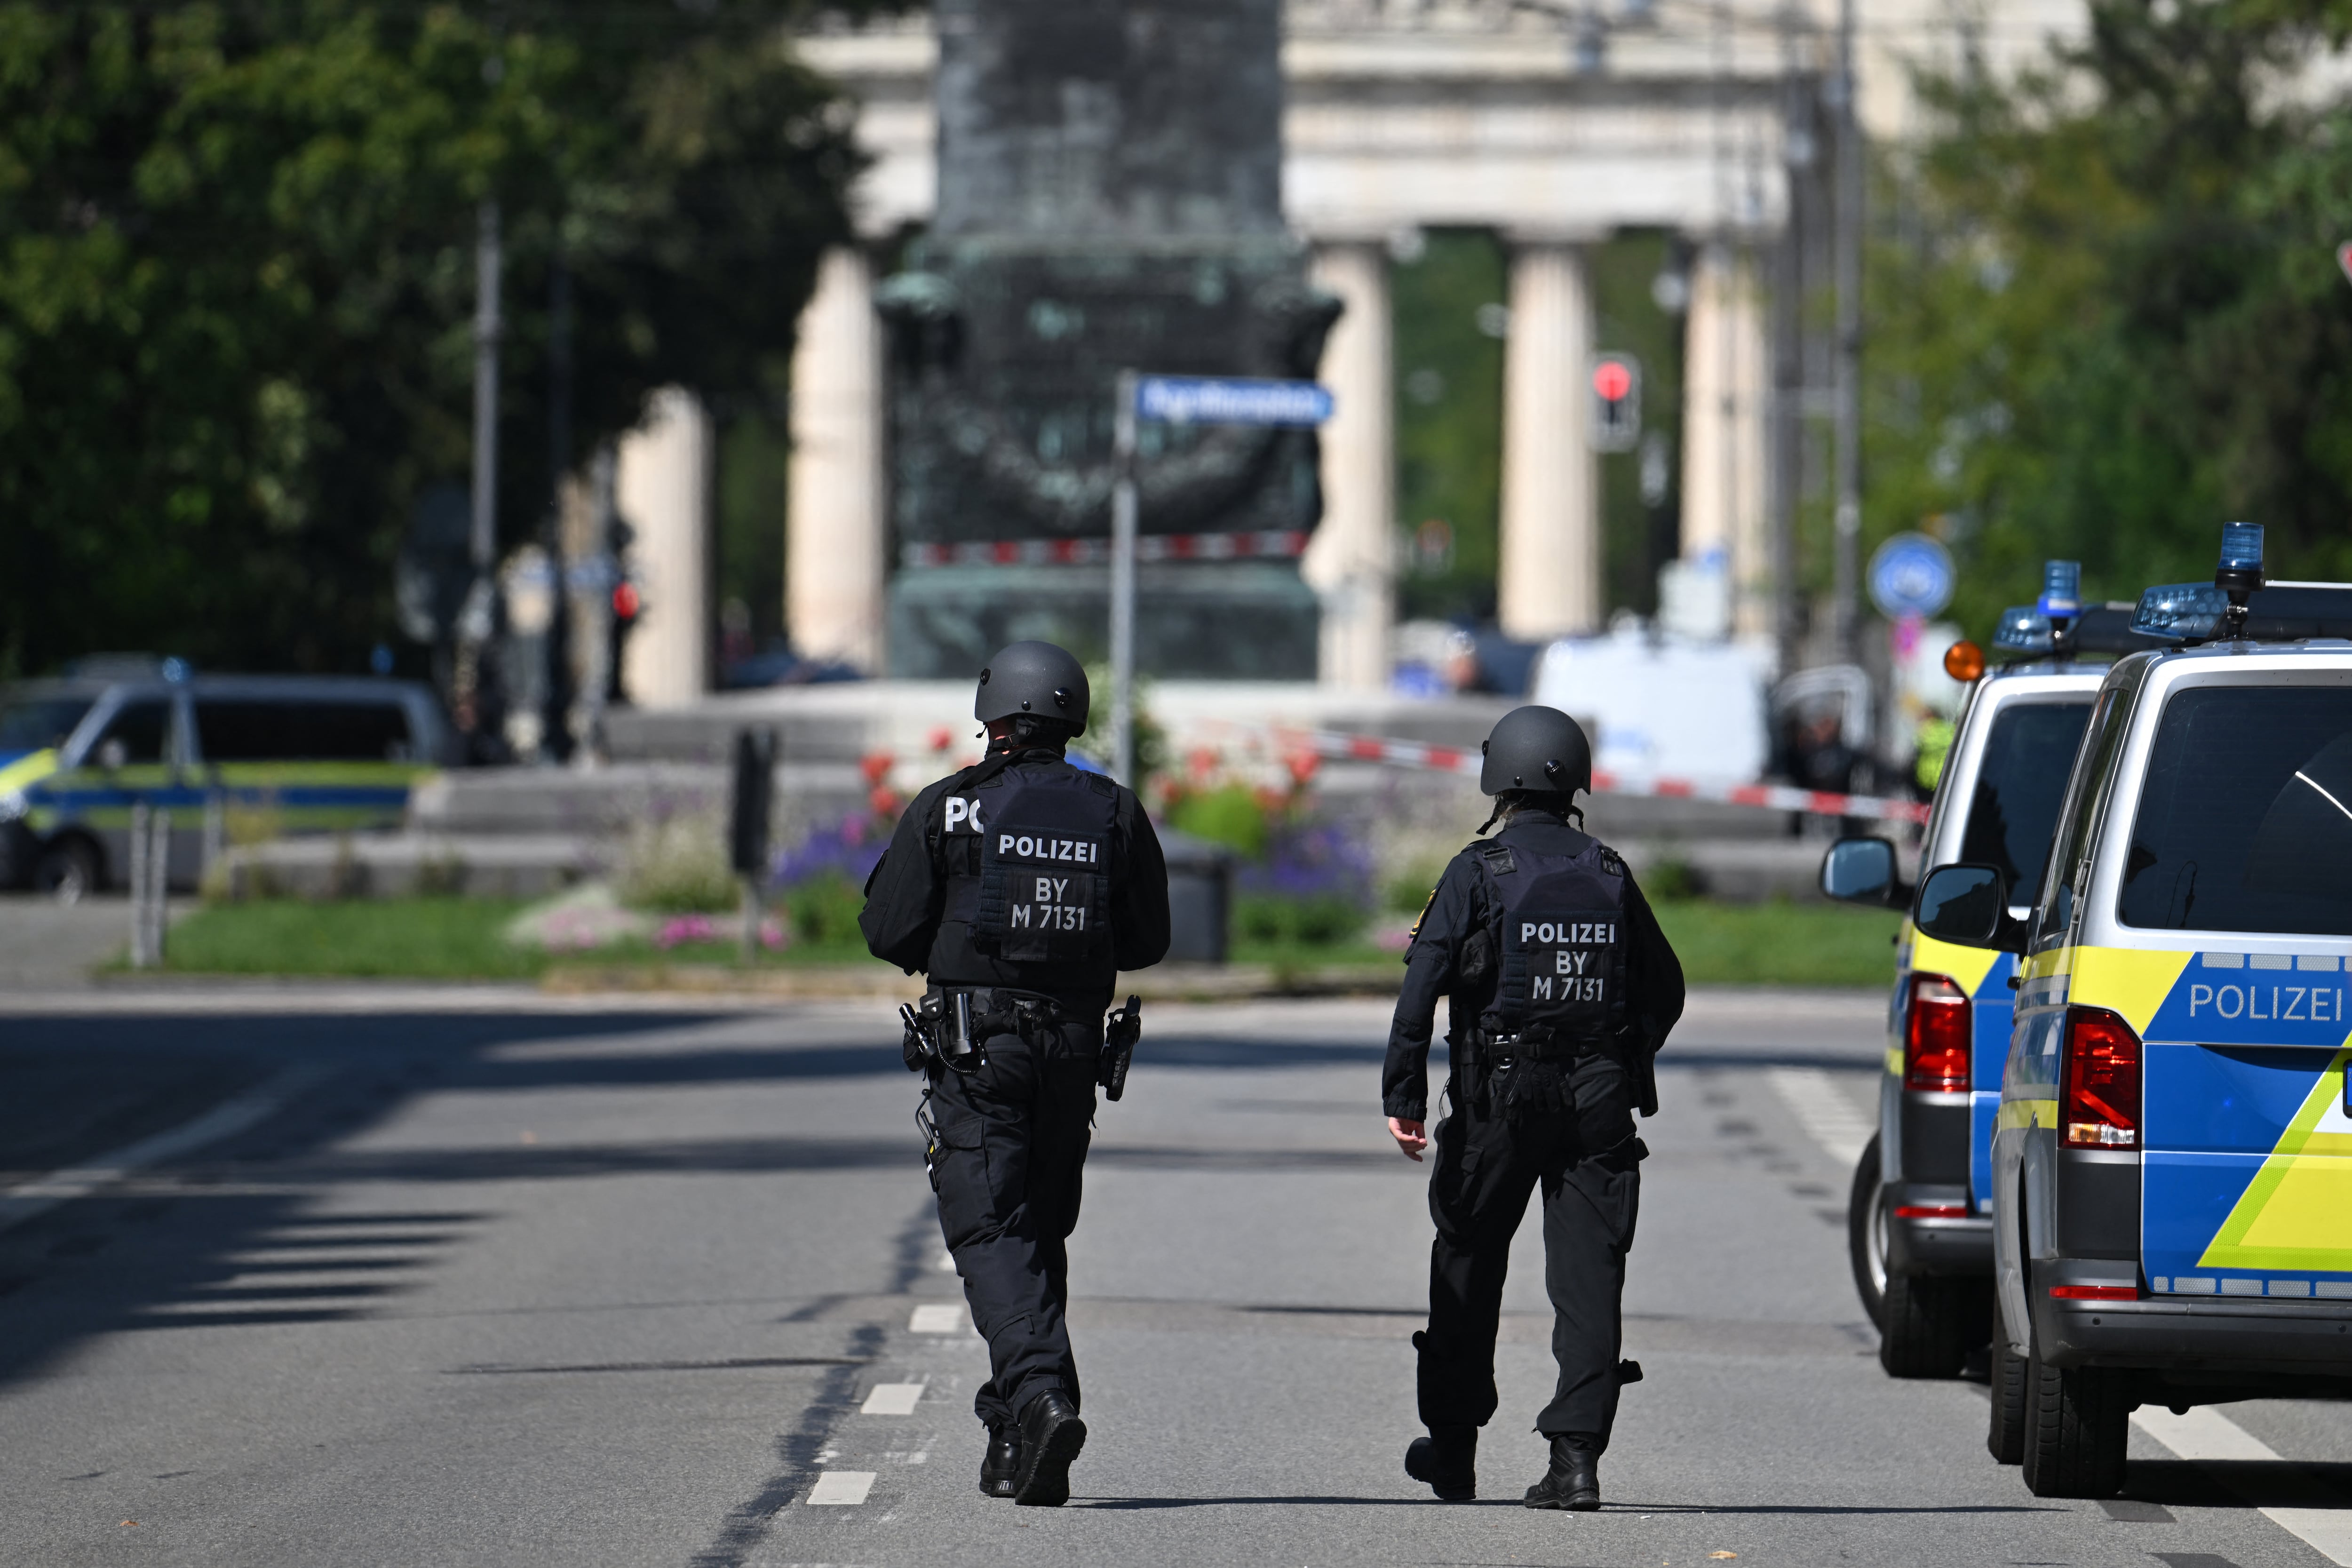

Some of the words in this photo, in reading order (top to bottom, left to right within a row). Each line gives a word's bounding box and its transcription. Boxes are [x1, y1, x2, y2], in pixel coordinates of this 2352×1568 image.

[999, 834, 1097, 863] POLIZEI
[1035, 877, 1068, 902] BY
[1011, 904, 1031, 928] M
[1039, 905, 1085, 931] 7131
[1521, 923, 1615, 943] POLIZEI
[1556, 951, 1588, 975] BY
[1532, 976, 1552, 1000] M
[1560, 977, 1604, 1002] 7131
[2190, 984, 2342, 1021] POLIZEI
